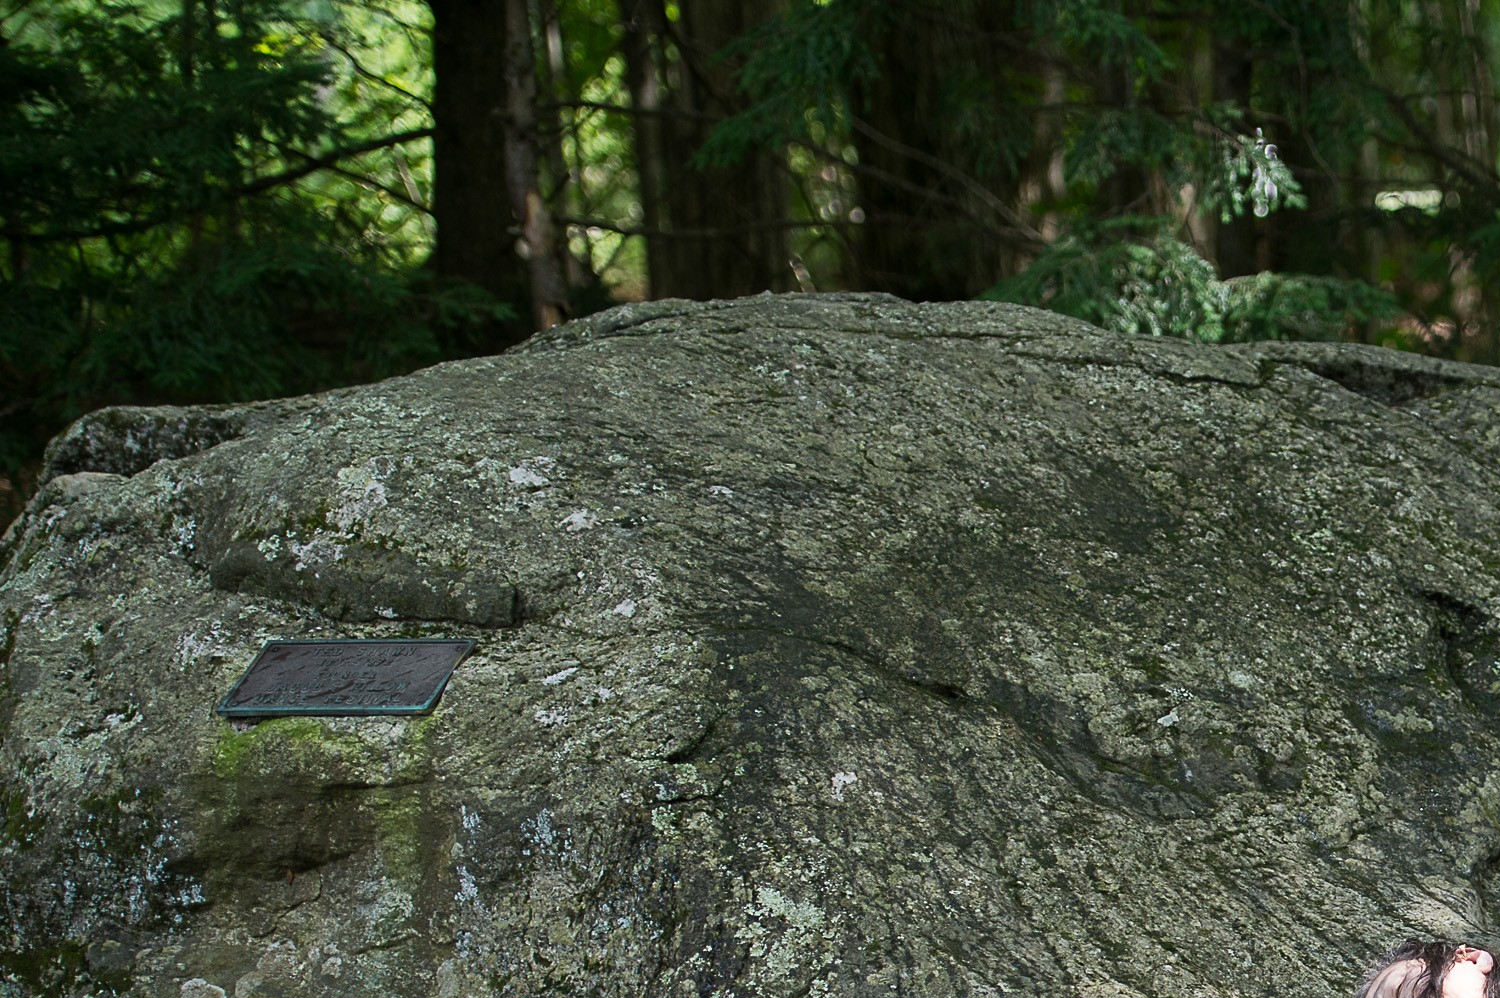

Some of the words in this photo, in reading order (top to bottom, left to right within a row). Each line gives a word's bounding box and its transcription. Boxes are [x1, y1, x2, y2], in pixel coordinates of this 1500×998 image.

[313, 648, 344, 658] TED
[355, 646, 418, 659] SHAWN
[314, 671, 378, 680] FOUNDER
[267, 682, 341, 693] JACOBS
[350, 681, 411, 693] PILLOW
[254, 694, 311, 705] DANCE
[323, 693, 403, 705] FESTIVAL
